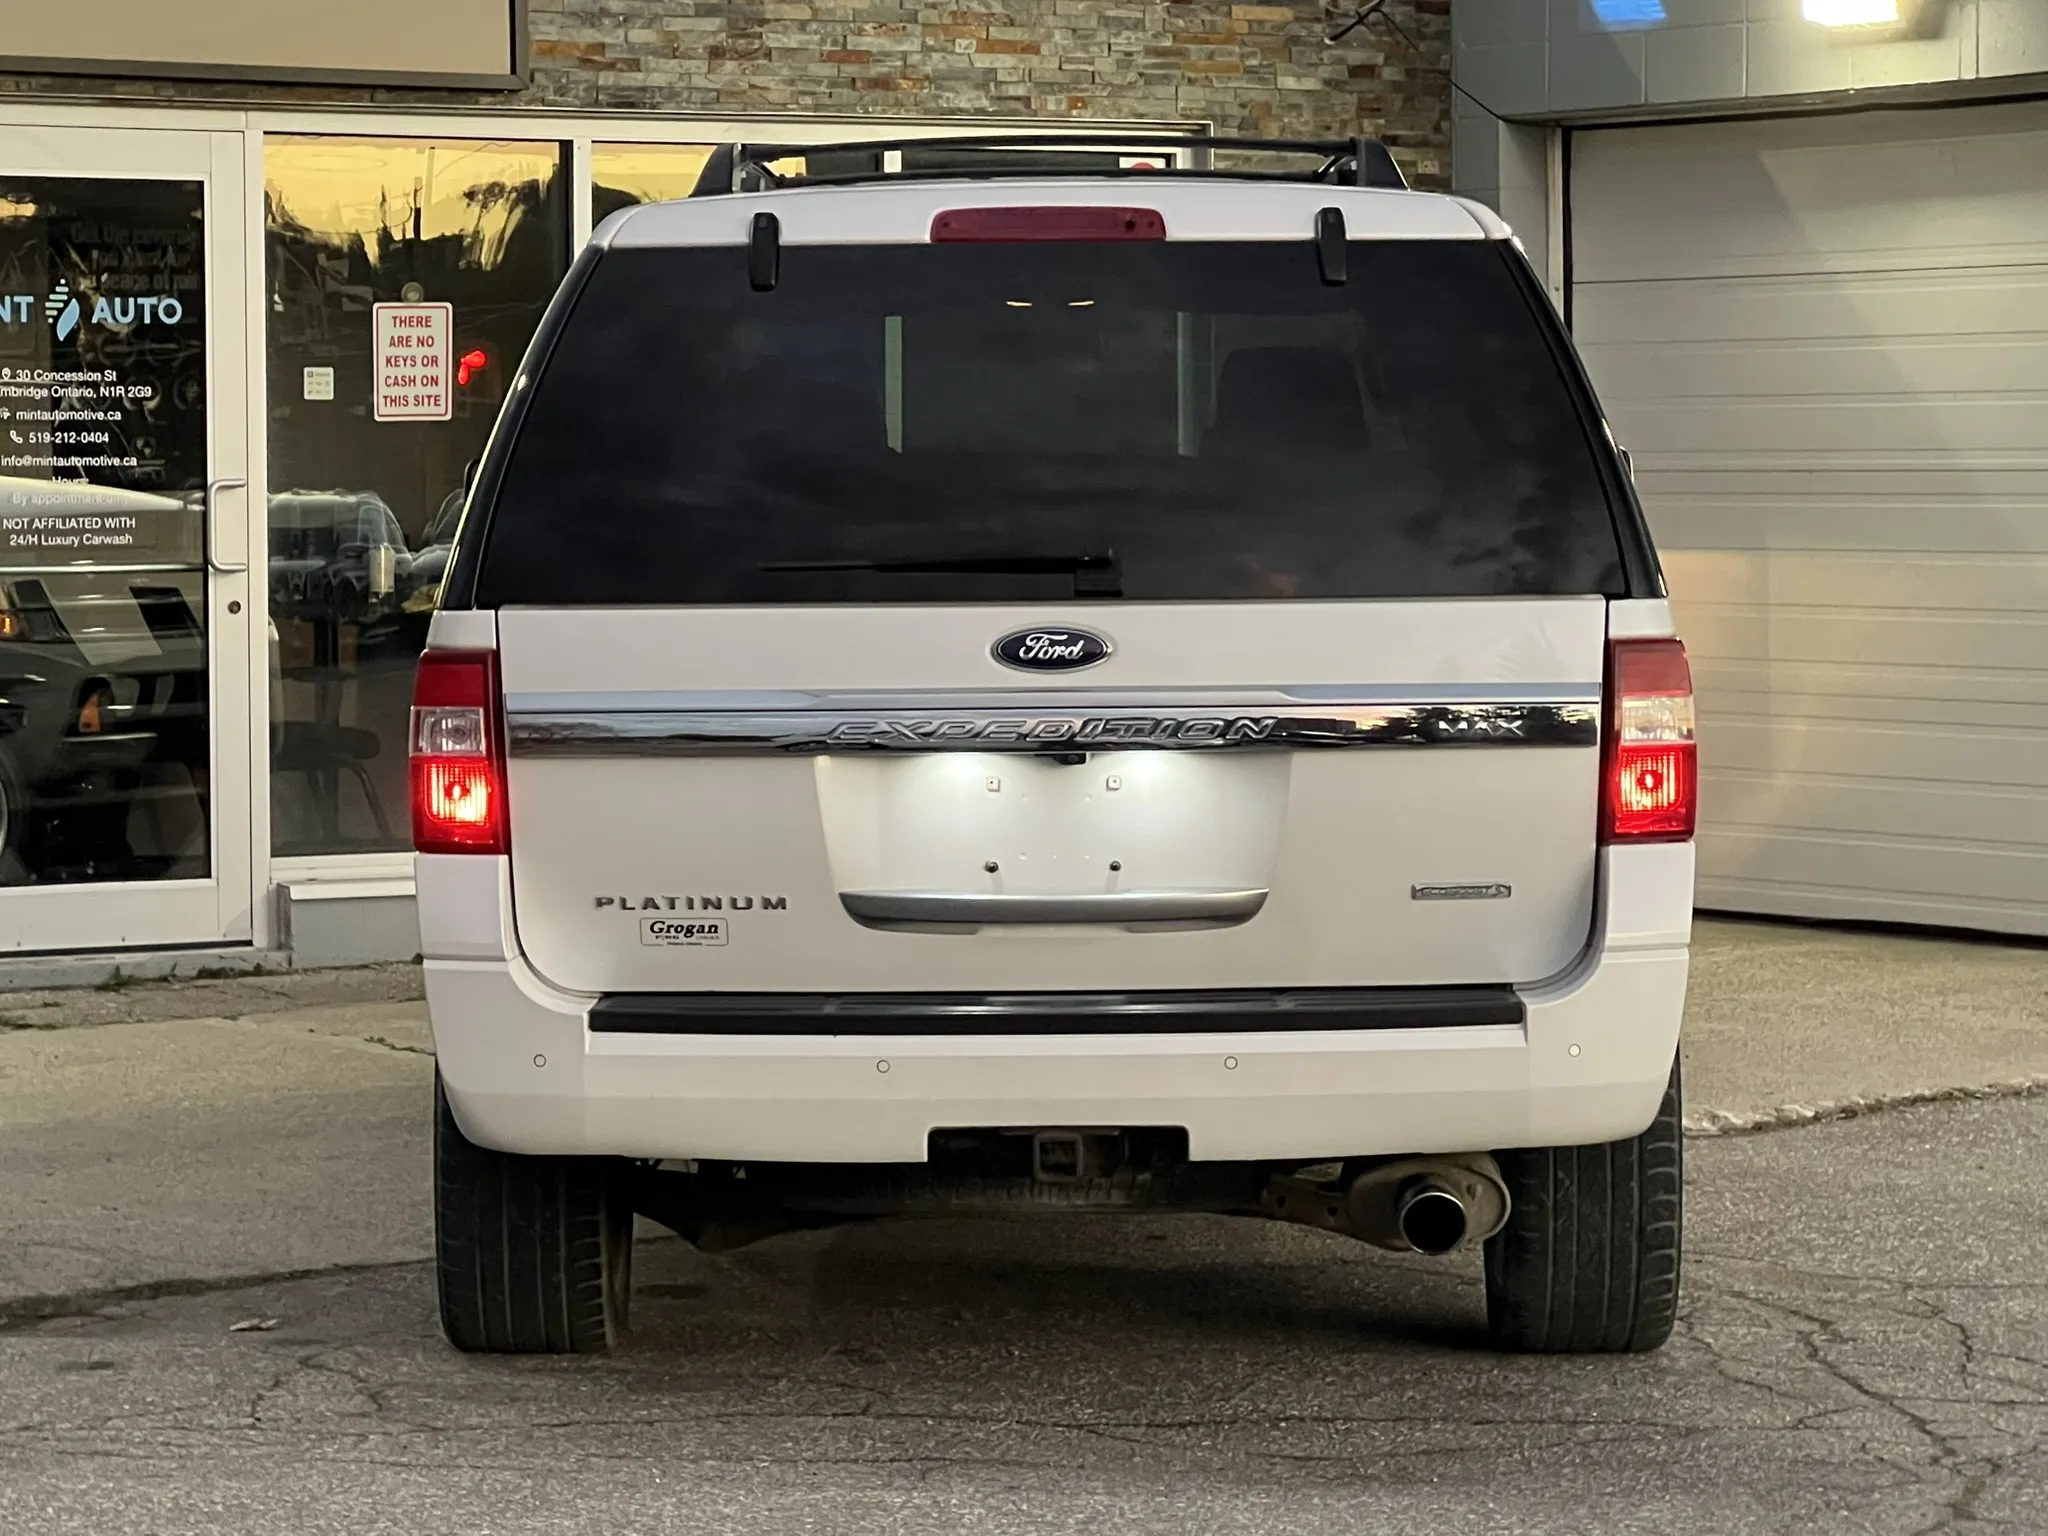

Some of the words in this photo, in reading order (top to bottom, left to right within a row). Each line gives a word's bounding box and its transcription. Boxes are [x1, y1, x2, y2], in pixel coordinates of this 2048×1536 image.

[91, 297, 182, 324] AUTO
[391, 315, 432, 328] THERE
[389, 335, 412, 347] ARE
[416, 335, 434, 347] NO
[385, 355, 417, 368] KEYS
[421, 355, 439, 367] OR
[16, 369, 31, 381] 30
[34, 369, 101, 381] Concession
[104, 369, 117, 381] St
[385, 375, 416, 387] CASH
[421, 375, 439, 387] ON
[51, 386, 97, 398] Ontario,
[100, 386, 125, 397] N1R
[128, 386, 152, 397] 2G9
[383, 395, 409, 407] THIS
[413, 395, 441, 407] SITE
[16, 409, 121, 420] mintautomotive.ca
[29, 432, 109, 443] 519-212-0404
[1, 455, 137, 467] info@mintautomotive.ca
[3, 518, 29, 529] NOT
[32, 518, 101, 529] AFFILIATED
[105, 517, 136, 528] WITH
[10, 534, 38, 546] 24/H
[41, 534, 79, 547] Luxury
[83, 533, 132, 545] Carwash
[1018, 633, 1083, 661] Ford
[825, 716, 1277, 744] EXPEDITION
[595, 896, 787, 911] PLATINUM
[649, 920, 719, 938] Grogan
